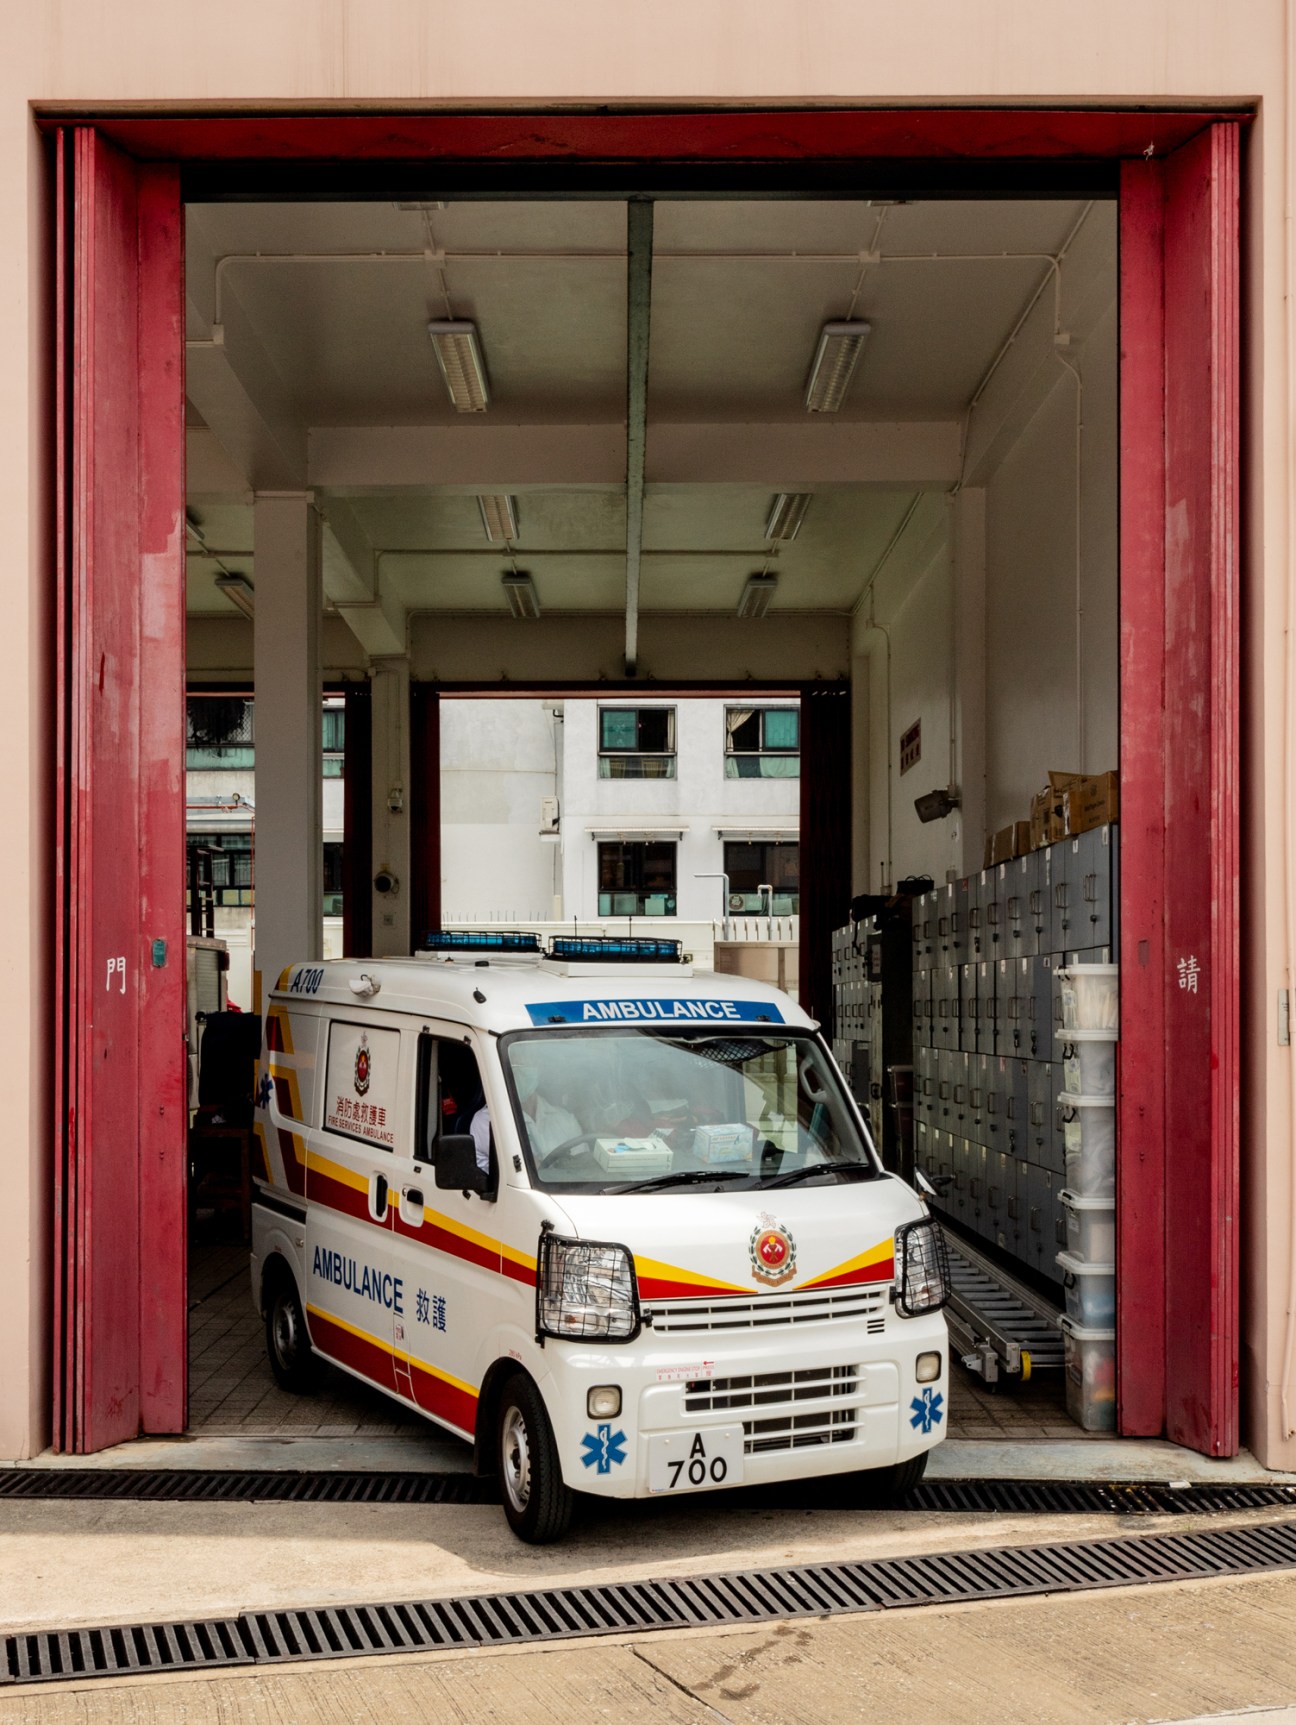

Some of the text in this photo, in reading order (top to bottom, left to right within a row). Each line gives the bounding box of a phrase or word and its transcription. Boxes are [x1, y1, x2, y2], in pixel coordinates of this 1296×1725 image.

[106, 956, 126, 995] 門
[290, 968, 324, 994] A700
[1177, 955, 1201, 994] 請
[583, 1002, 741, 1020] AMBULANCE
[328, 1115, 394, 1144] FIRE SERVICES AMBULANCE
[313, 1245, 404, 1314] AMBULANCE
[416, 1288, 447, 1332] 救護
[689, 1432, 706, 1459] A
[667, 1456, 727, 1489] 700
